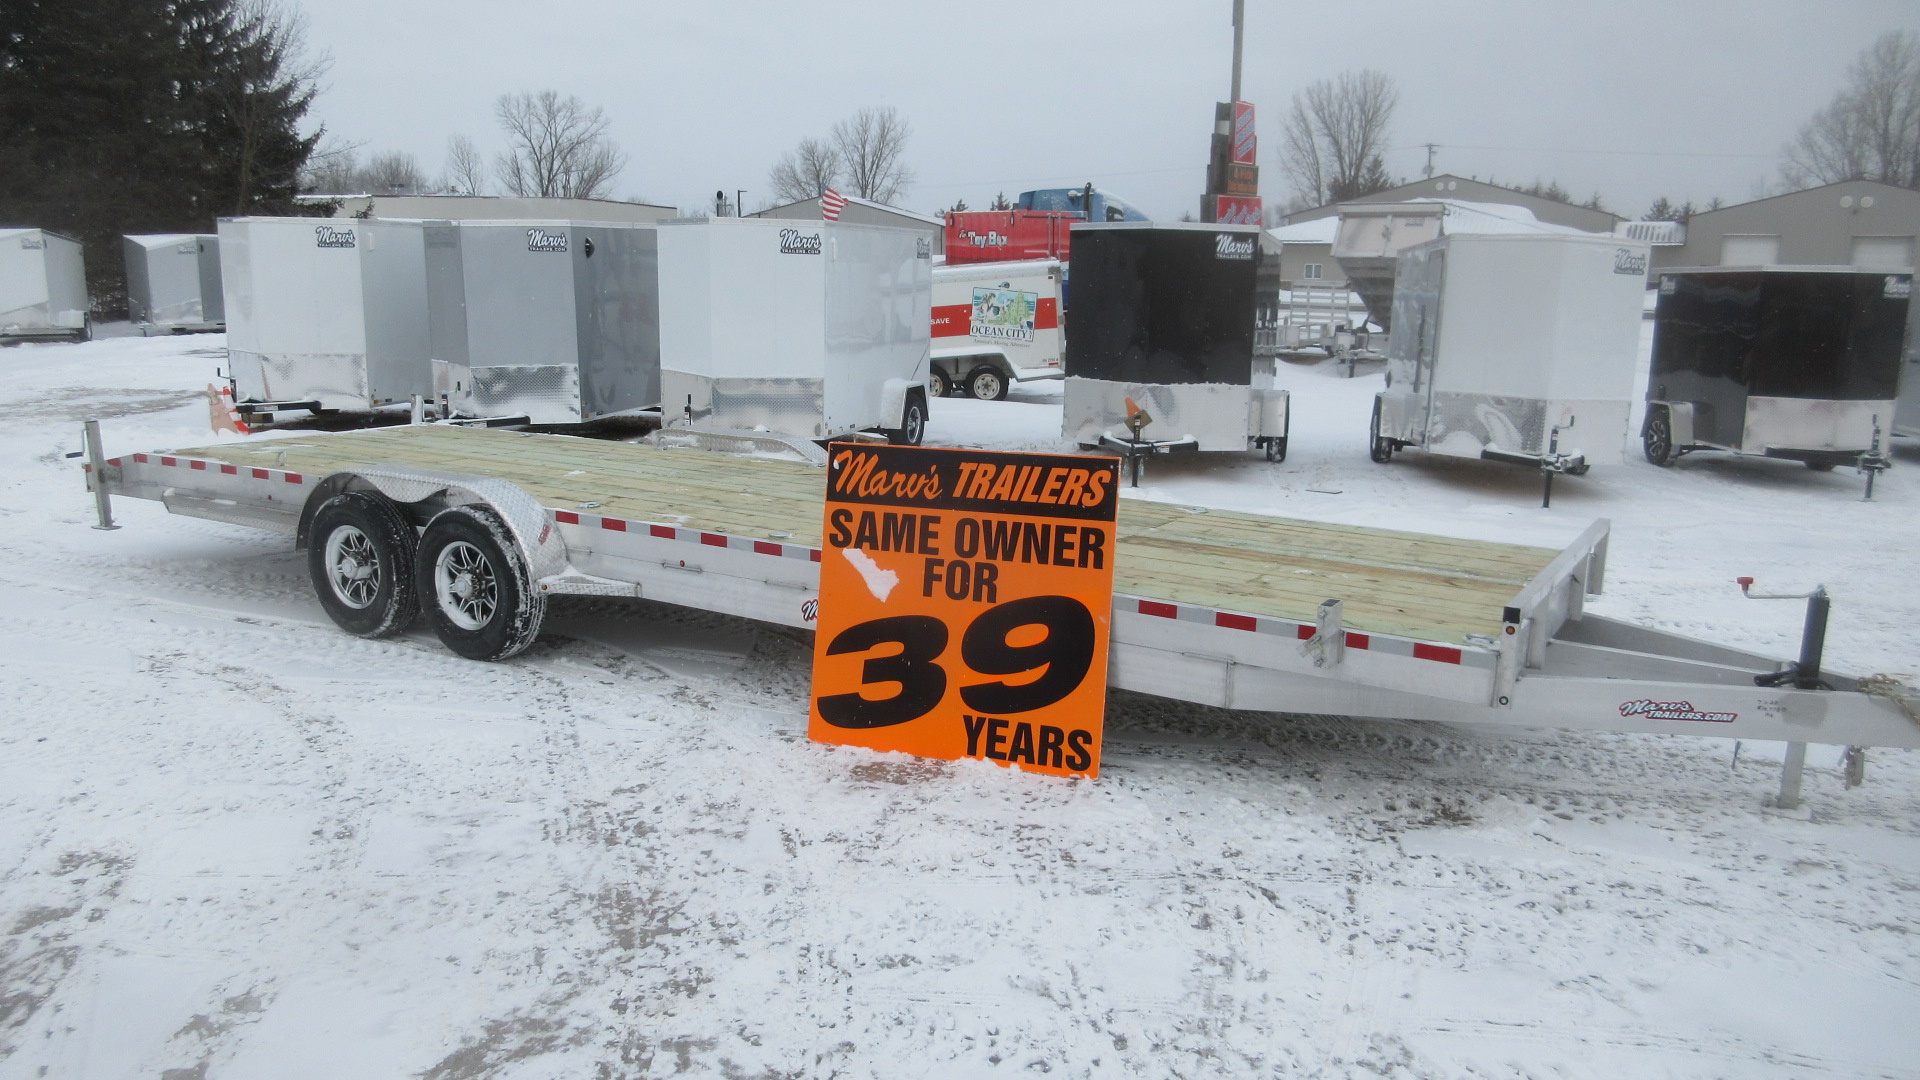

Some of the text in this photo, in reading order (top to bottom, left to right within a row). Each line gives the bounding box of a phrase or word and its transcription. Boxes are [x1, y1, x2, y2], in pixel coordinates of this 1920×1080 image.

[316, 226, 355, 243] Marv's
[528, 229, 567, 247] Marv's
[780, 229, 821, 249] Marv's
[968, 231, 987, 249] Toy
[988, 231, 1008, 246] Box
[1216, 234, 1254, 254] Marv's
[930, 317, 950, 325] SAVE
[971, 325, 1005, 336] OCEAN
[1006, 328, 1028, 339] CITY
[833, 450, 1112, 507] Marv's TRAILERS
[829, 508, 1105, 569] SAME OWNER
[922, 558, 999, 603] FOR
[816, 595, 1096, 729] 39
[1620, 700, 1692, 715] Marv's
[1648, 710, 1735, 721] TRAILERS.COM
[962, 714, 1093, 771] YEARS
